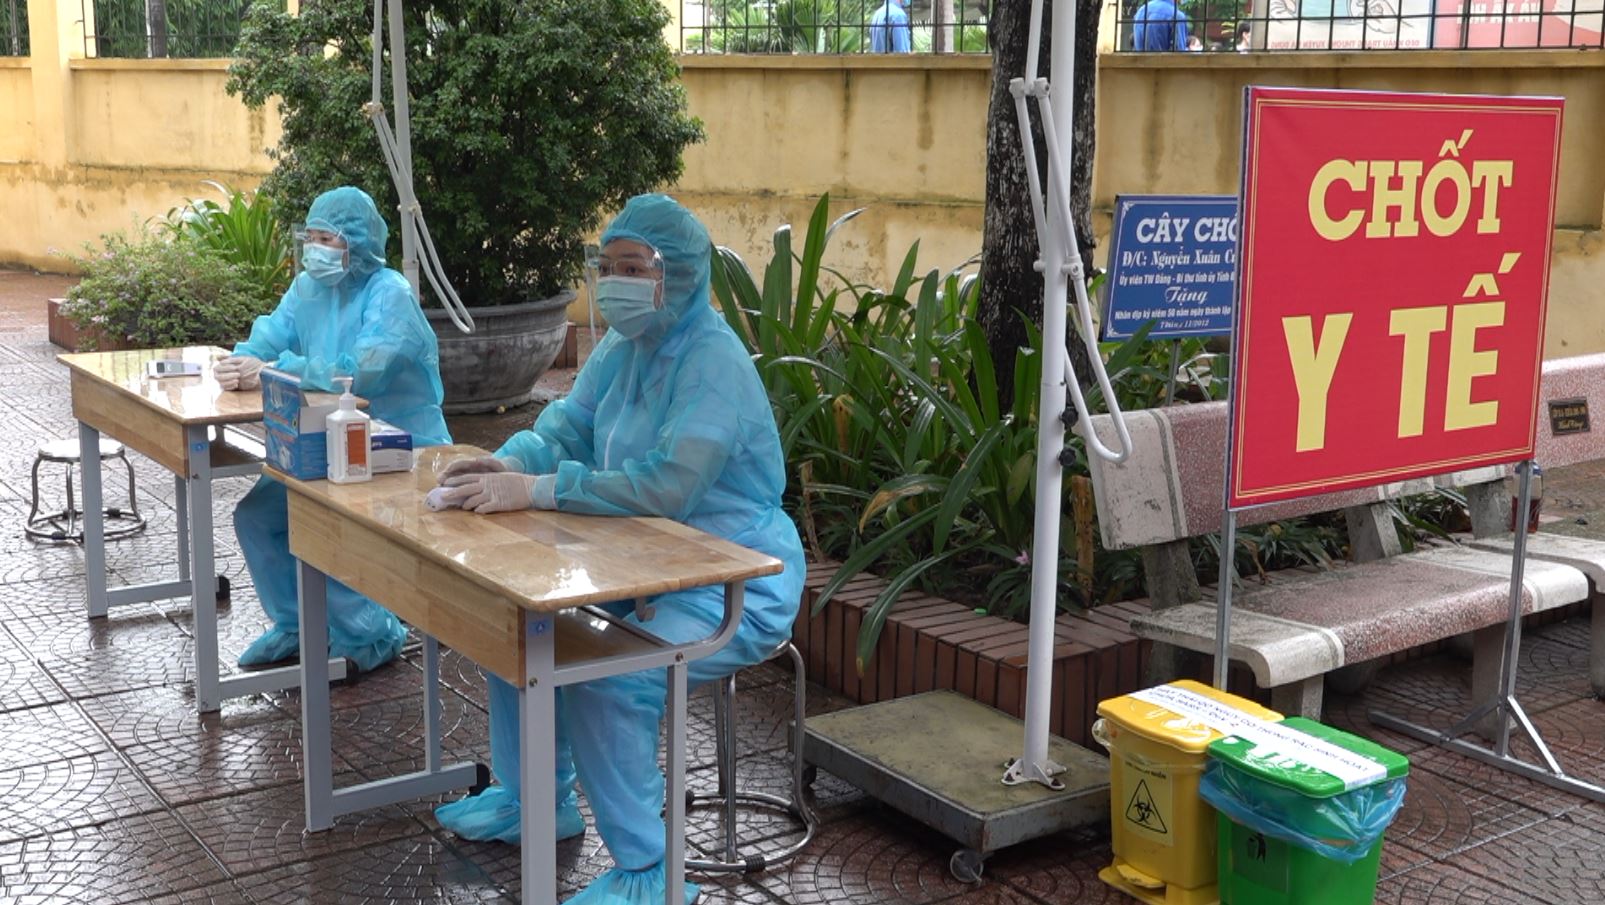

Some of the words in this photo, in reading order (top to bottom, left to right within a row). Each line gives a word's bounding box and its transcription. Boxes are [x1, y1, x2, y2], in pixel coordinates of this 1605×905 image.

[1308, 129, 1514, 241] CHỐT
[1135, 212, 1190, 243] CÂY
[1122, 250, 1148, 269] Đ/C:
[1193, 249, 1220, 265] Xuân
[1164, 286, 1208, 306] Tặng
[1281, 313, 1354, 453] Y
[1388, 252, 1522, 439] TẾ
